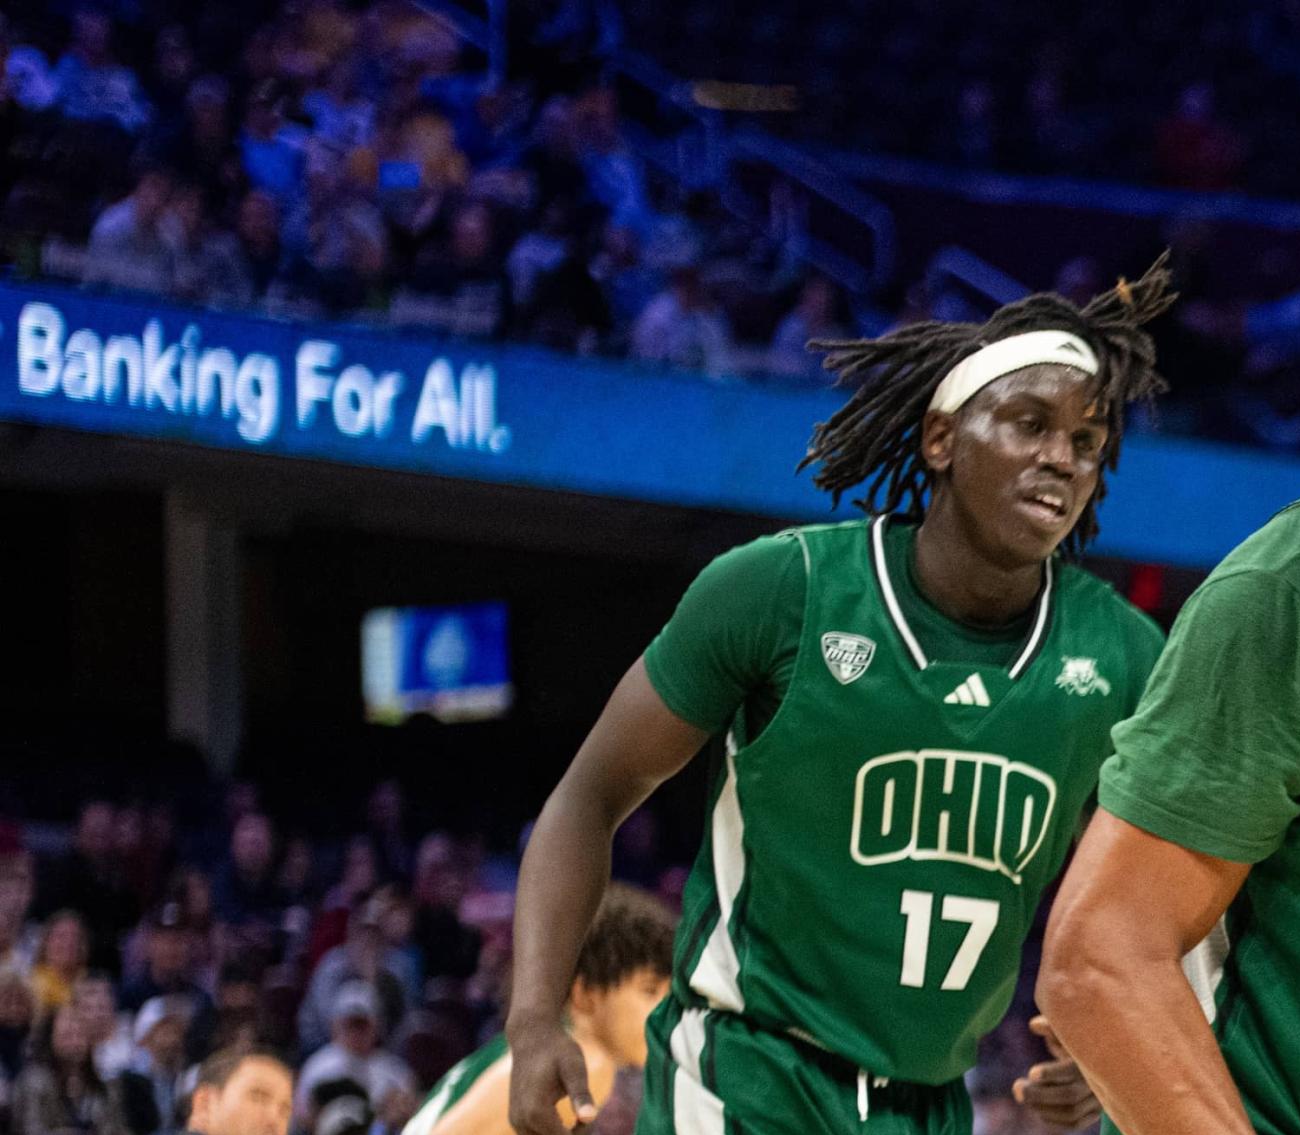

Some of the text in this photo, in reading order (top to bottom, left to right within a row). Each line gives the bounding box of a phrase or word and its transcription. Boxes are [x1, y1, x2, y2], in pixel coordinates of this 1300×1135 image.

[18, 301, 512, 454] Banking For All.
[850, 748, 1057, 884] OHIO
[900, 889, 1000, 991] 17
